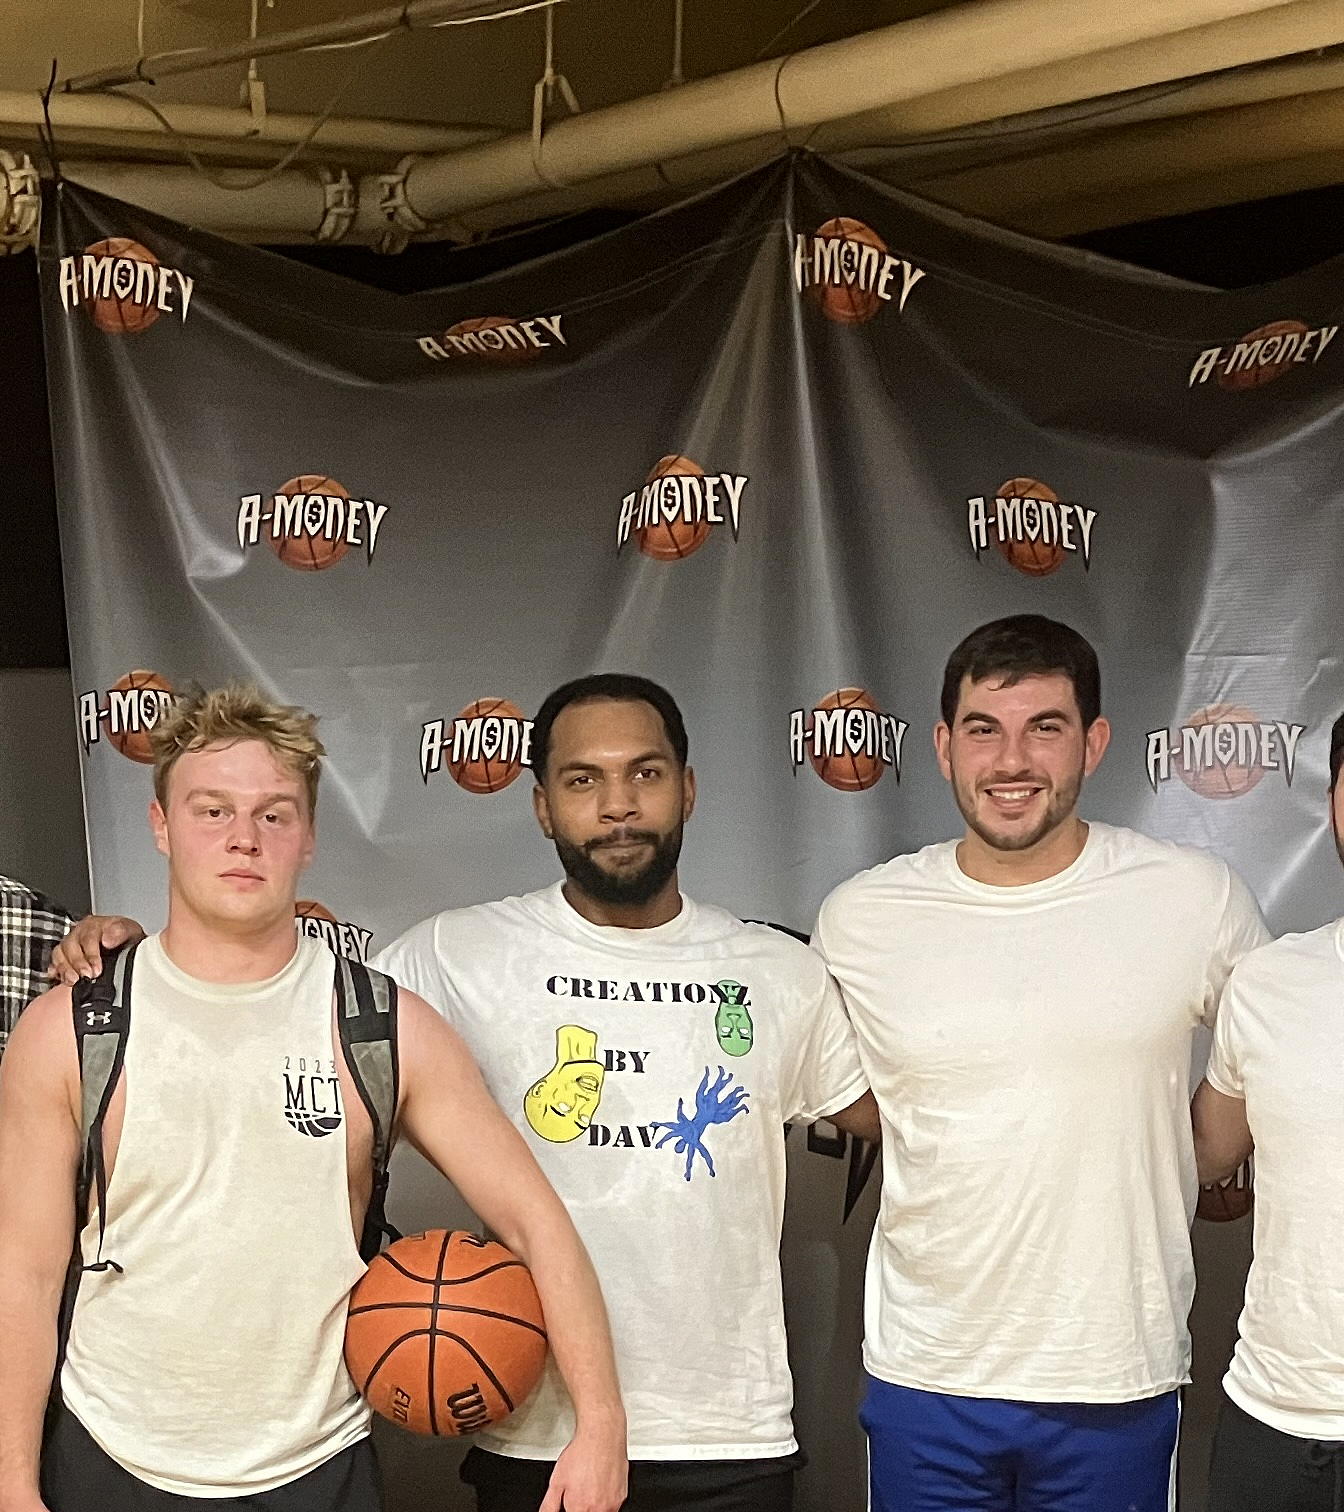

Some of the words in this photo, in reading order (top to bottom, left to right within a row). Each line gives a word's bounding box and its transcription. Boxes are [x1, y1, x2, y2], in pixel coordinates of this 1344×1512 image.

[59, 255, 195, 324] A-MONEY
[416, 314, 568, 361] A-MONEY
[1189, 325, 1339, 388] A-MONEY
[236, 493, 389, 560] A-MONEY
[617, 473, 748, 550] A-MONEY
[968, 497, 1097, 561] A-MONEY
[420, 716, 535, 782] A-MONE
[789, 709, 910, 780] A-MONEY
[1146, 719, 1305, 787] A-MONEY
[284, 1056, 336, 1073] 2023
[603, 1049, 651, 1073] BY
[283, 1073, 341, 1115] MCT
